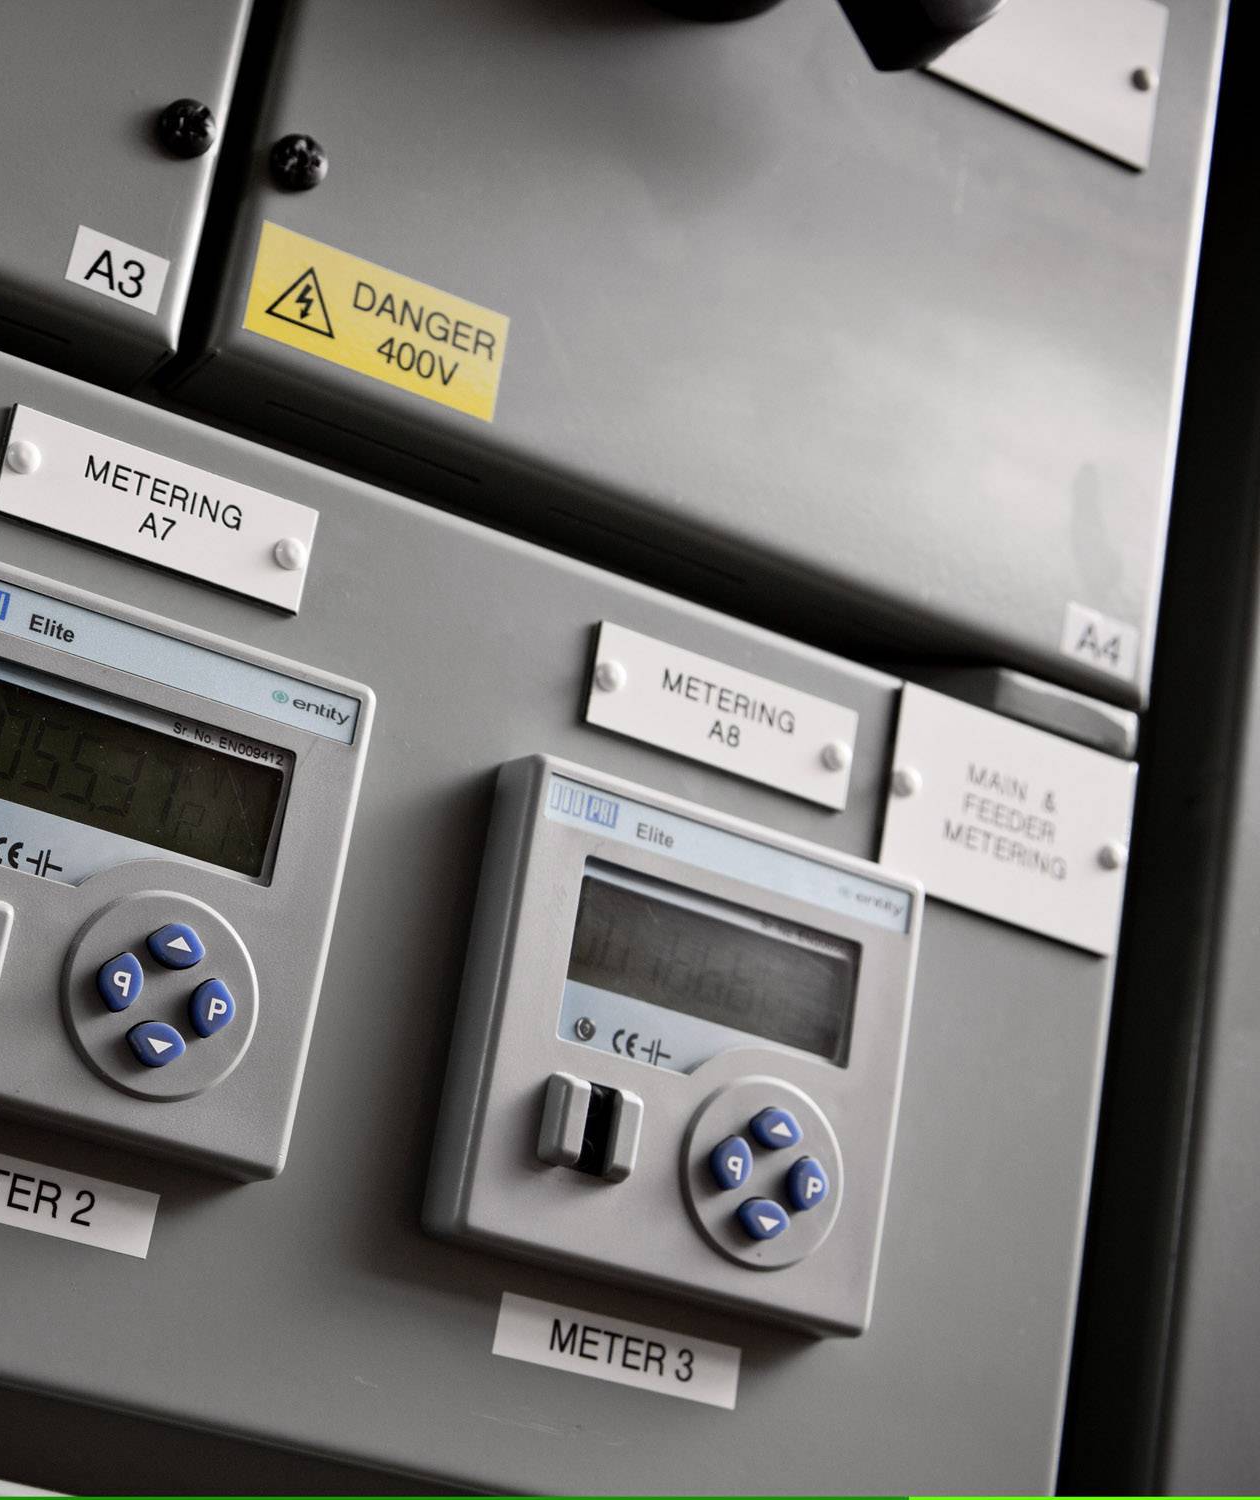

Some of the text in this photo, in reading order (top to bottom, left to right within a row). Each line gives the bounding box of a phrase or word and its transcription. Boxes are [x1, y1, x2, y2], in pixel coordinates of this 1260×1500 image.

[84, 249, 146, 300] A3
[353, 281, 497, 362] DANGER
[376, 337, 461, 387] 400V
[84, 455, 243, 531] METERING
[138, 513, 177, 542] A7
[28, 613, 75, 643] Elite
[1075, 623, 1123, 669] A4
[292, 698, 351, 726] entity
[661, 668, 796, 734] METERING
[173, 721, 285, 767] Sr. No. EN009412
[708, 720, 740, 748] A8
[967, 762, 1057, 814] MAIN &
[636, 822, 675, 849] Elite
[962, 792, 1057, 845] FEEDER
[942, 818, 1068, 881] METERING
[208, 998, 228, 1021] P
[70, 1190, 97, 1227] 2
[806, 1176, 823, 1200] P
[549, 1318, 696, 1384] METER 3
